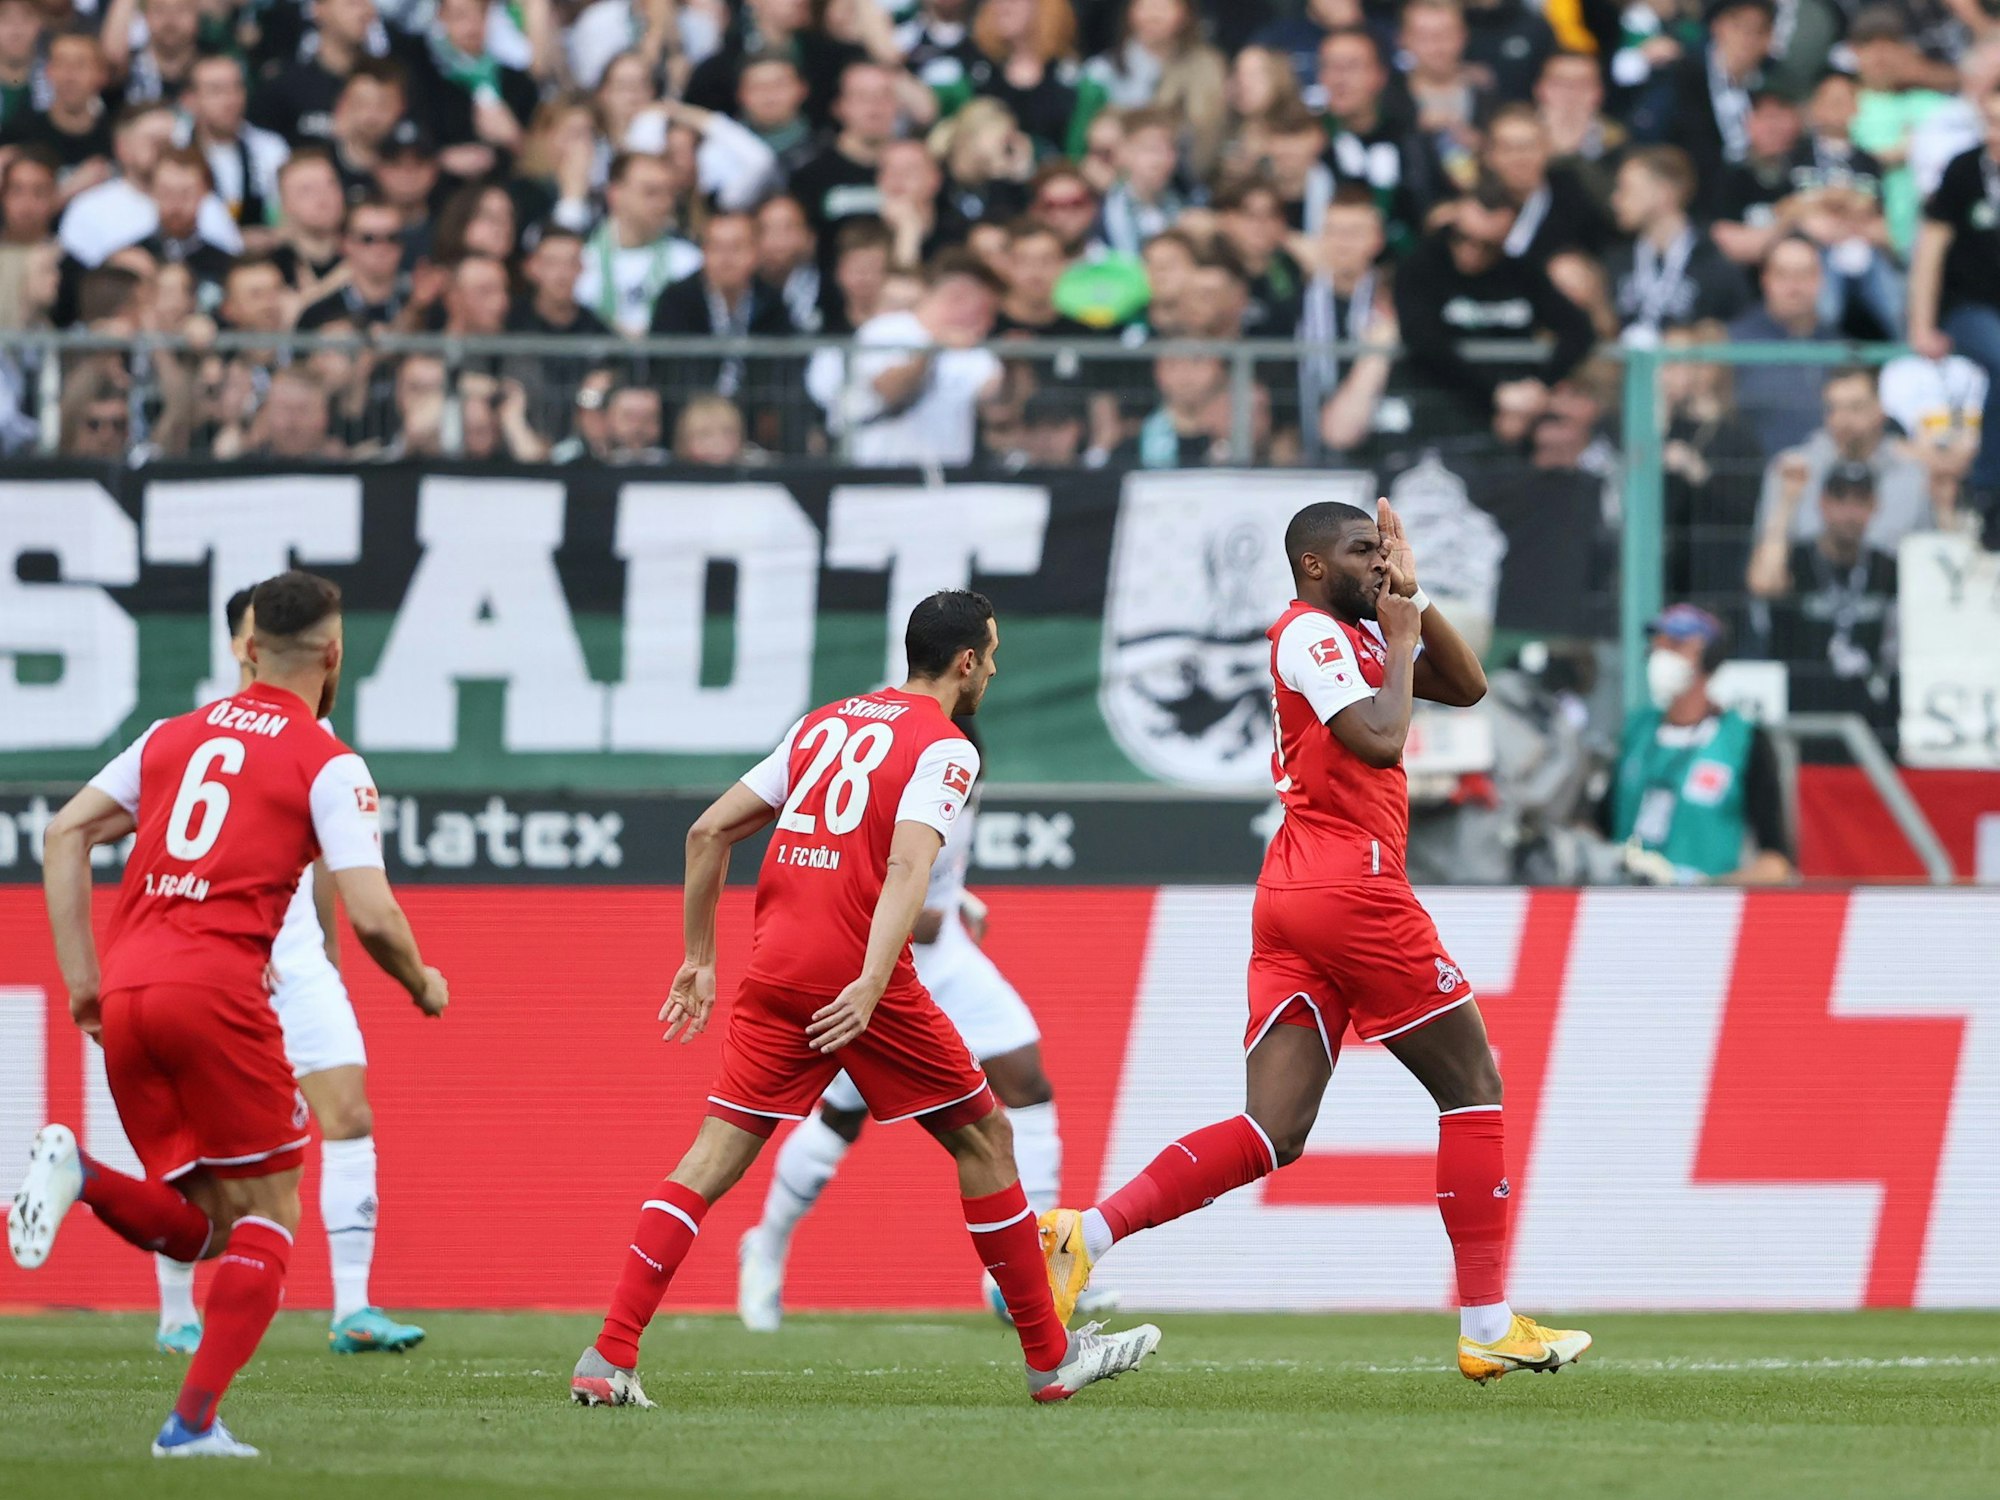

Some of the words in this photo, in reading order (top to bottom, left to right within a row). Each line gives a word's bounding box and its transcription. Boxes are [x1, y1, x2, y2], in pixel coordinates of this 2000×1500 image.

[0, 475, 1051, 753] STADT
[206, 699, 290, 738] ÖZCAN
[837, 697, 910, 722] SKHIRI
[165, 736, 246, 862] 6
[776, 716, 894, 836] 28
[777, 844, 786, 864] 1.
[807, 845, 841, 871] KÖLN
